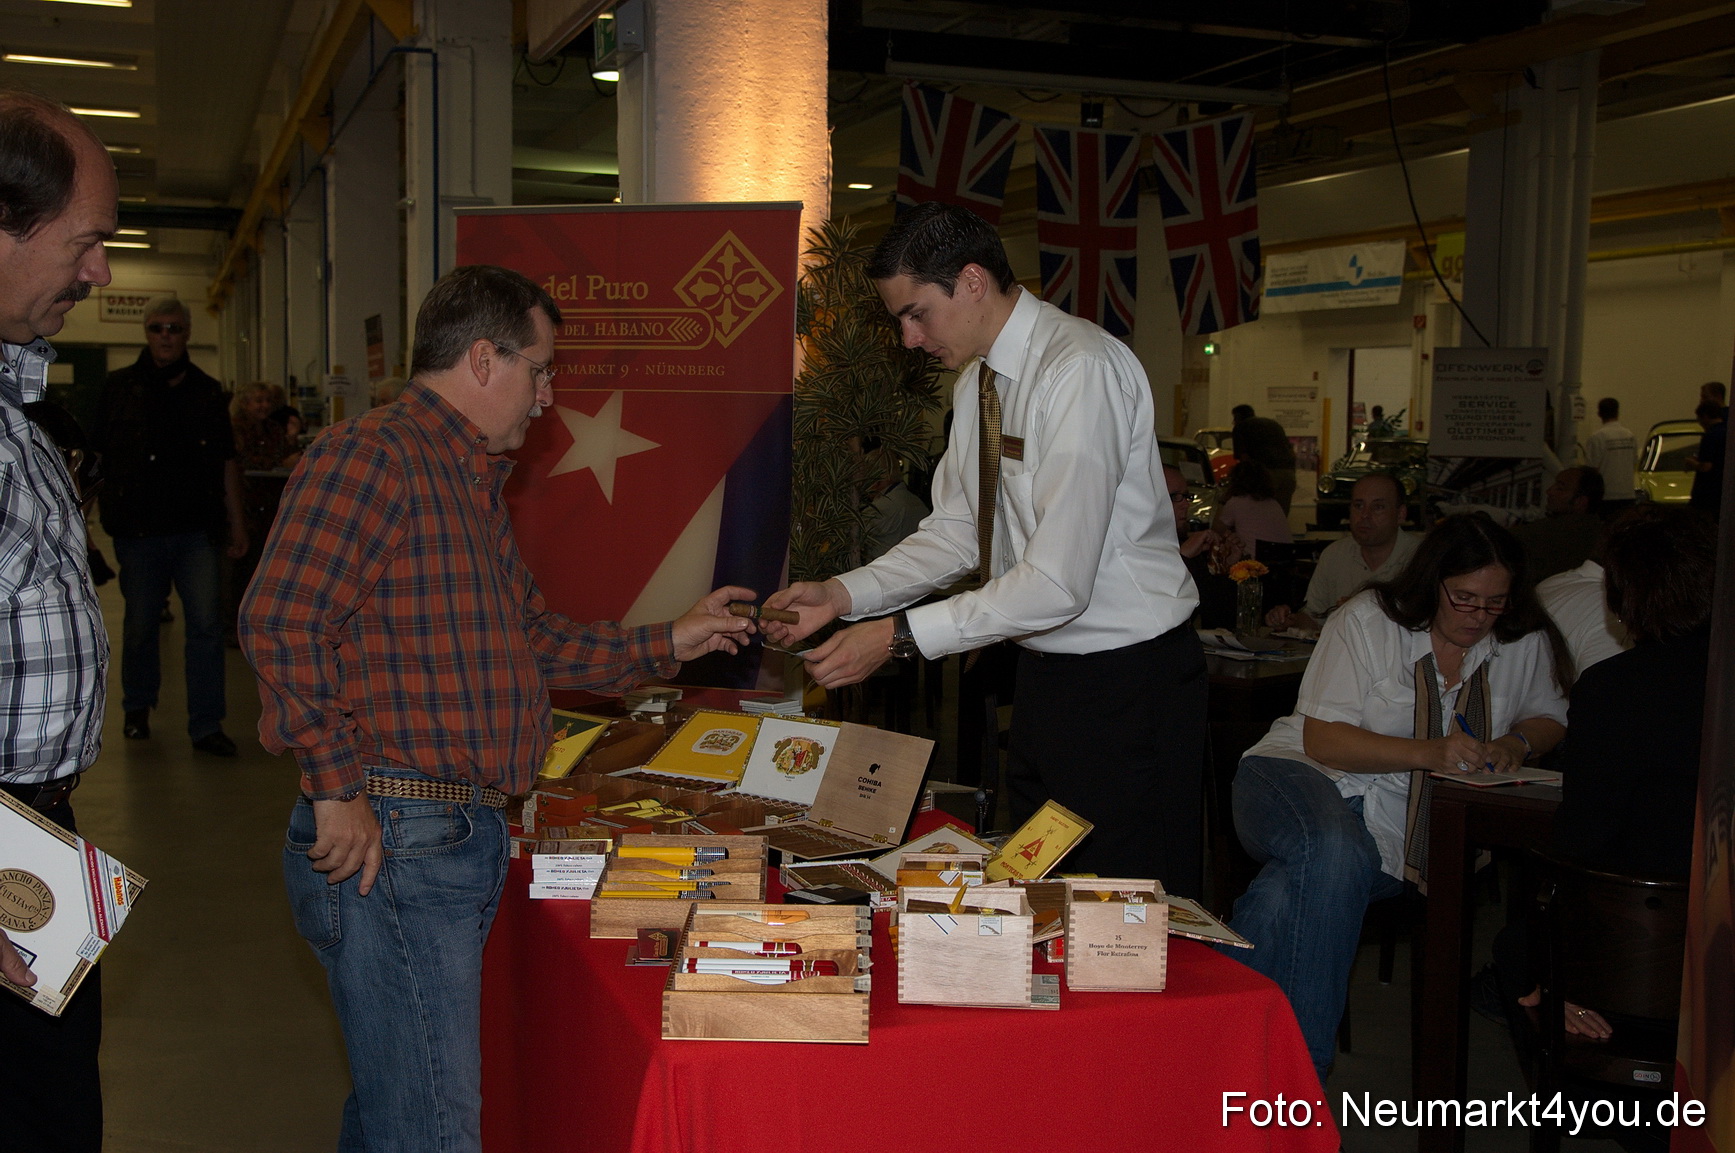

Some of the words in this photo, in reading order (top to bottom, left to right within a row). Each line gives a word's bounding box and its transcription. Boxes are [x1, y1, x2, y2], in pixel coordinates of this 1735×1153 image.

[542, 275, 579, 300] del
[585, 275, 649, 300] Puro
[564, 324, 589, 336] DEL
[594, 322, 665, 336] HABANO
[620, 364, 629, 378] 9
[645, 361, 725, 377] NÜRNBERG
[1436, 363, 1524, 373] OFENWERK
[1447, 427, 1515, 435] OLDTIMER
[857, 776, 882, 787] COHIBA
[32, 881, 51, 911] PANZA
[114, 876, 125, 906] Habanos
[0, 913, 26, 929] BANA
